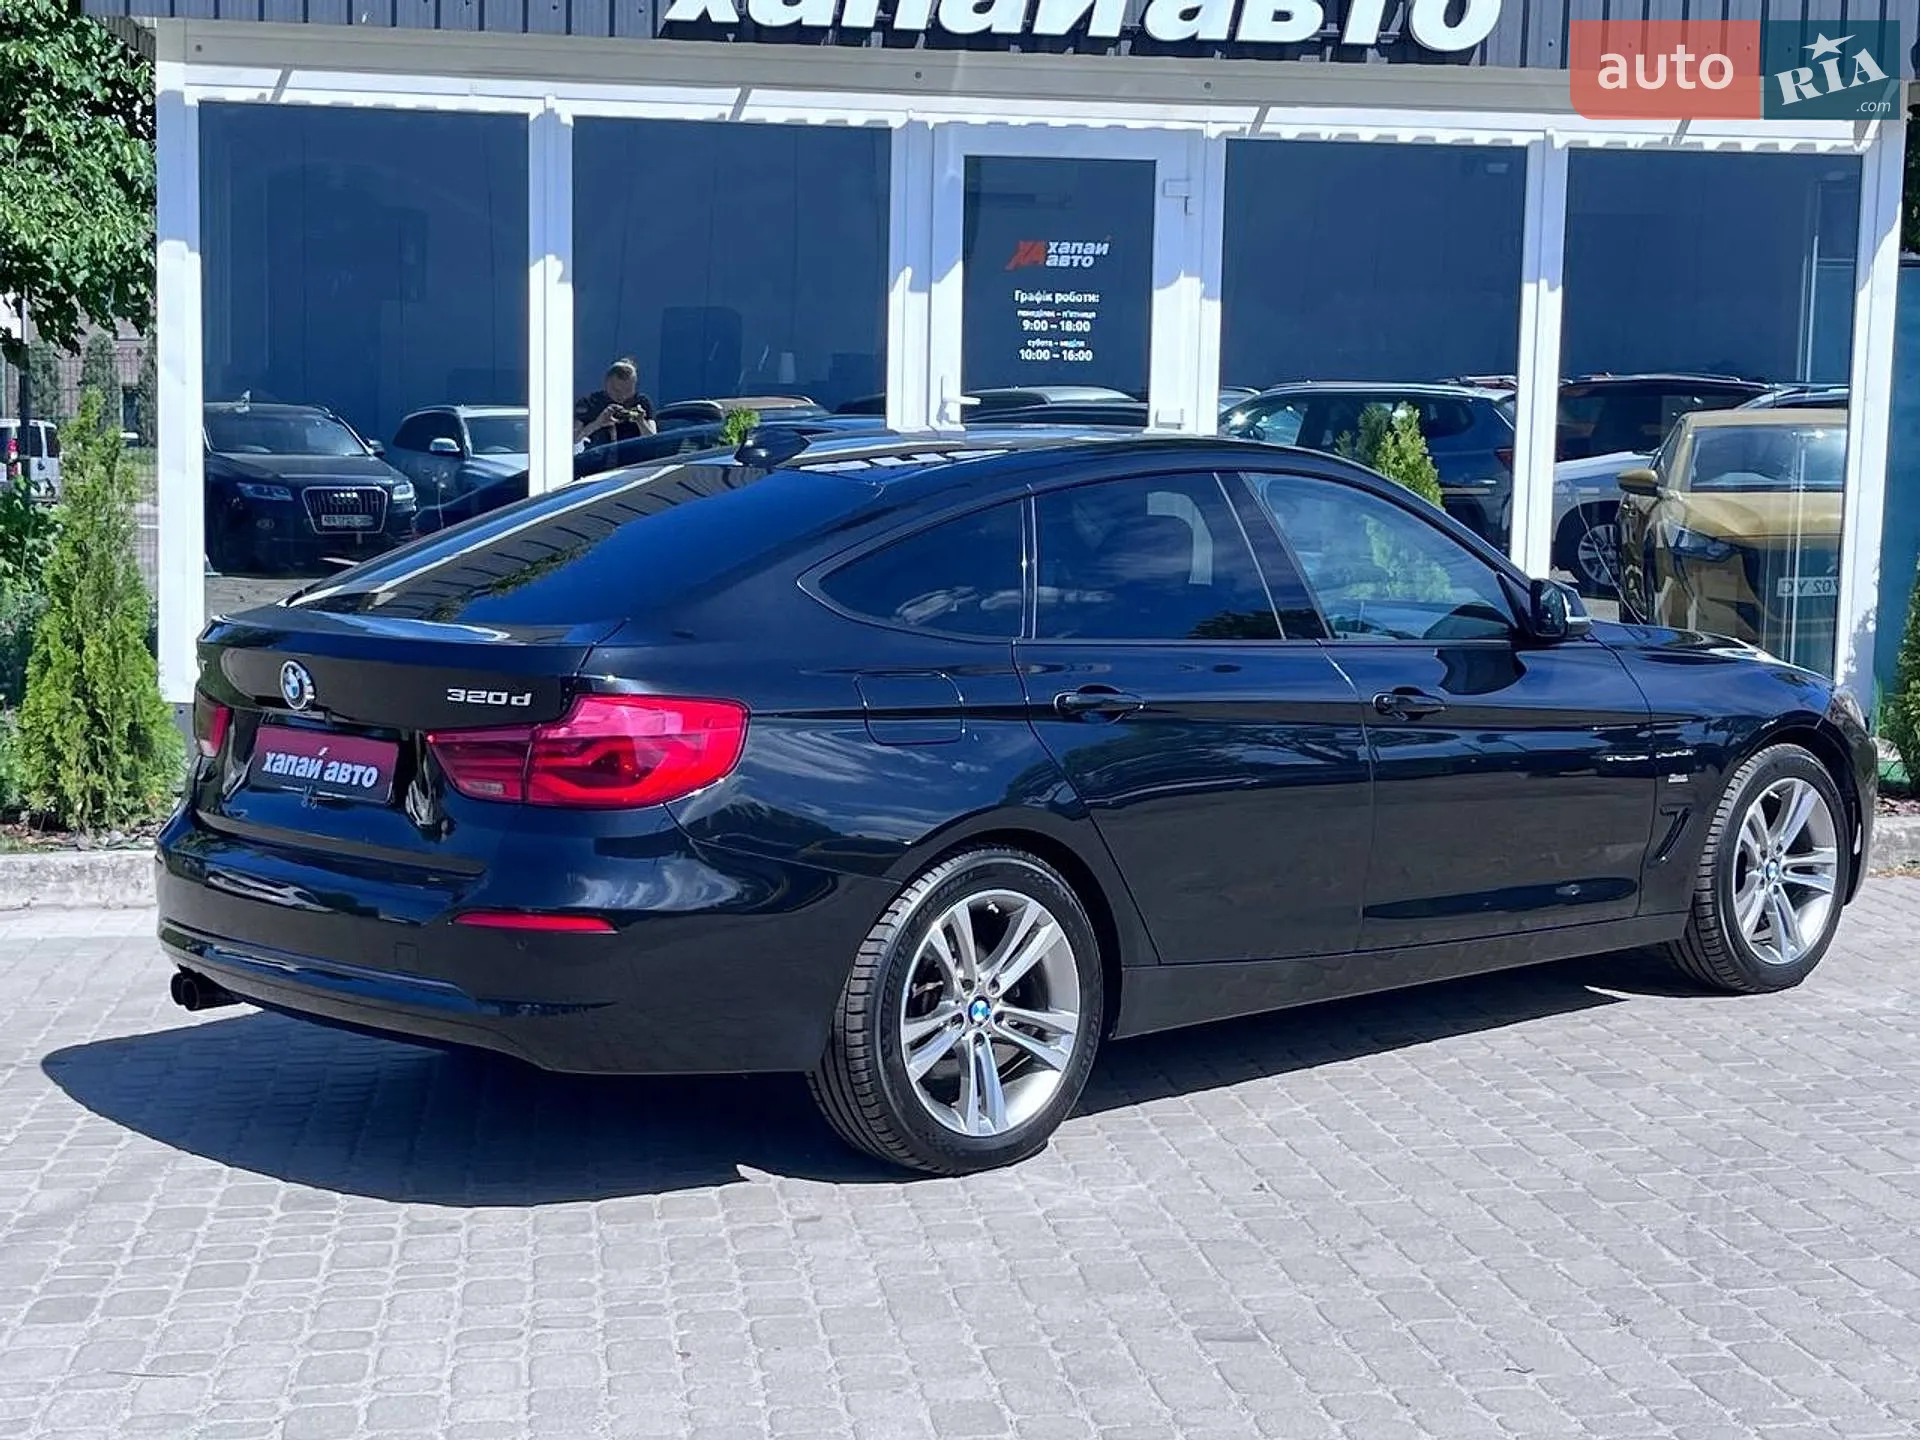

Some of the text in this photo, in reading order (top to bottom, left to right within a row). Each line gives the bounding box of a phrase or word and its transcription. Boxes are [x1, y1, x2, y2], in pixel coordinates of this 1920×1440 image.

[1045, 254, 1095, 268] авто
[1014, 289, 1100, 304] Графік роботи:
[1022, 320, 1048, 331] 9:00
[1060, 320, 1091, 332] 18:00
[1019, 349, 1050, 360] 10:00
[1062, 350, 1093, 361] 16:00
[262, 747, 378, 788] хапай авто
